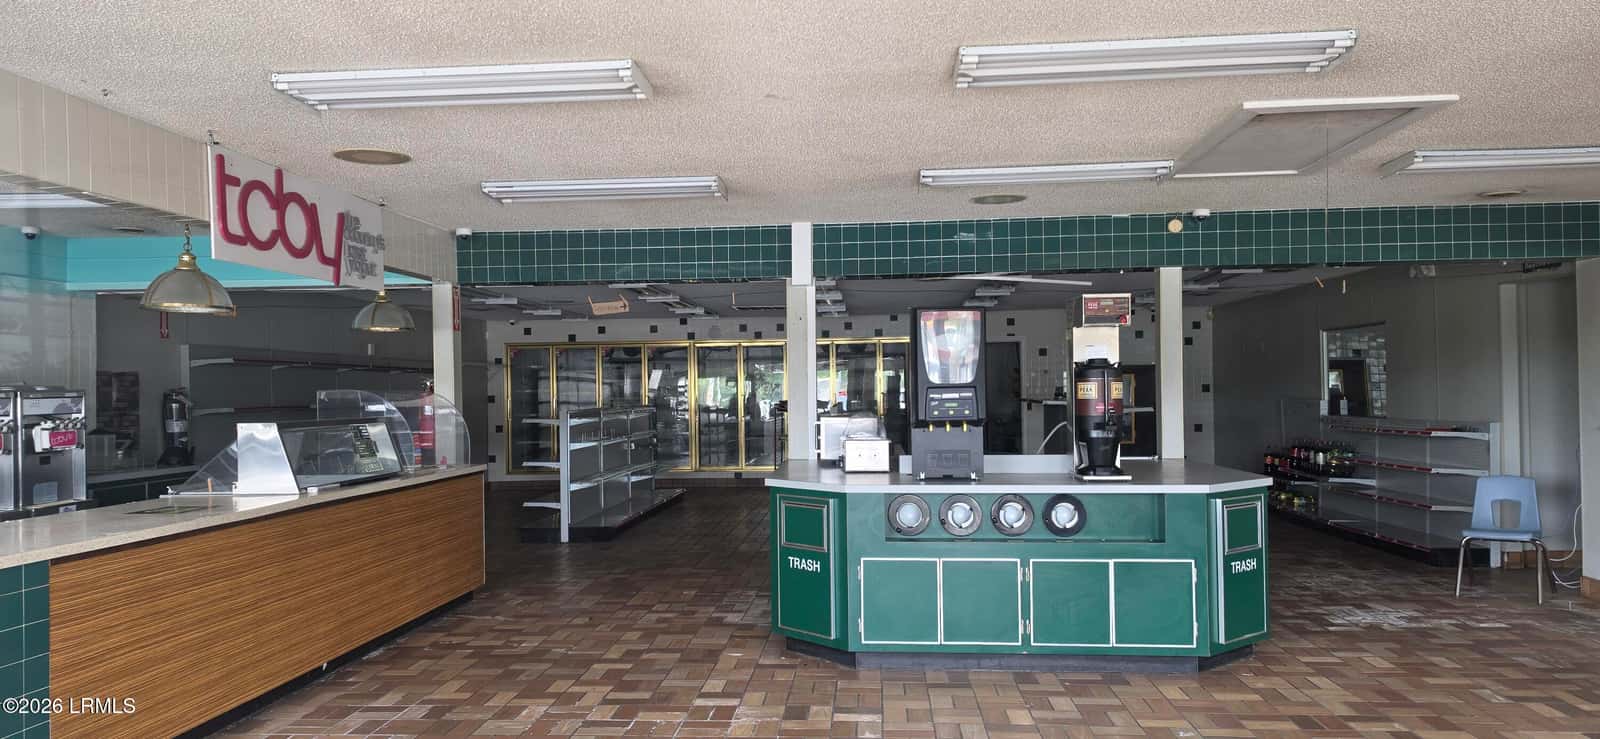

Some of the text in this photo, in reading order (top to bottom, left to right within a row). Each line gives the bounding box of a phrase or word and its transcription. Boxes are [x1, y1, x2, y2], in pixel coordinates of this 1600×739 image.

[215, 153, 346, 287] tcby
[787, 556, 821, 573] TRASH
[1230, 557, 1257, 575] TRASH
